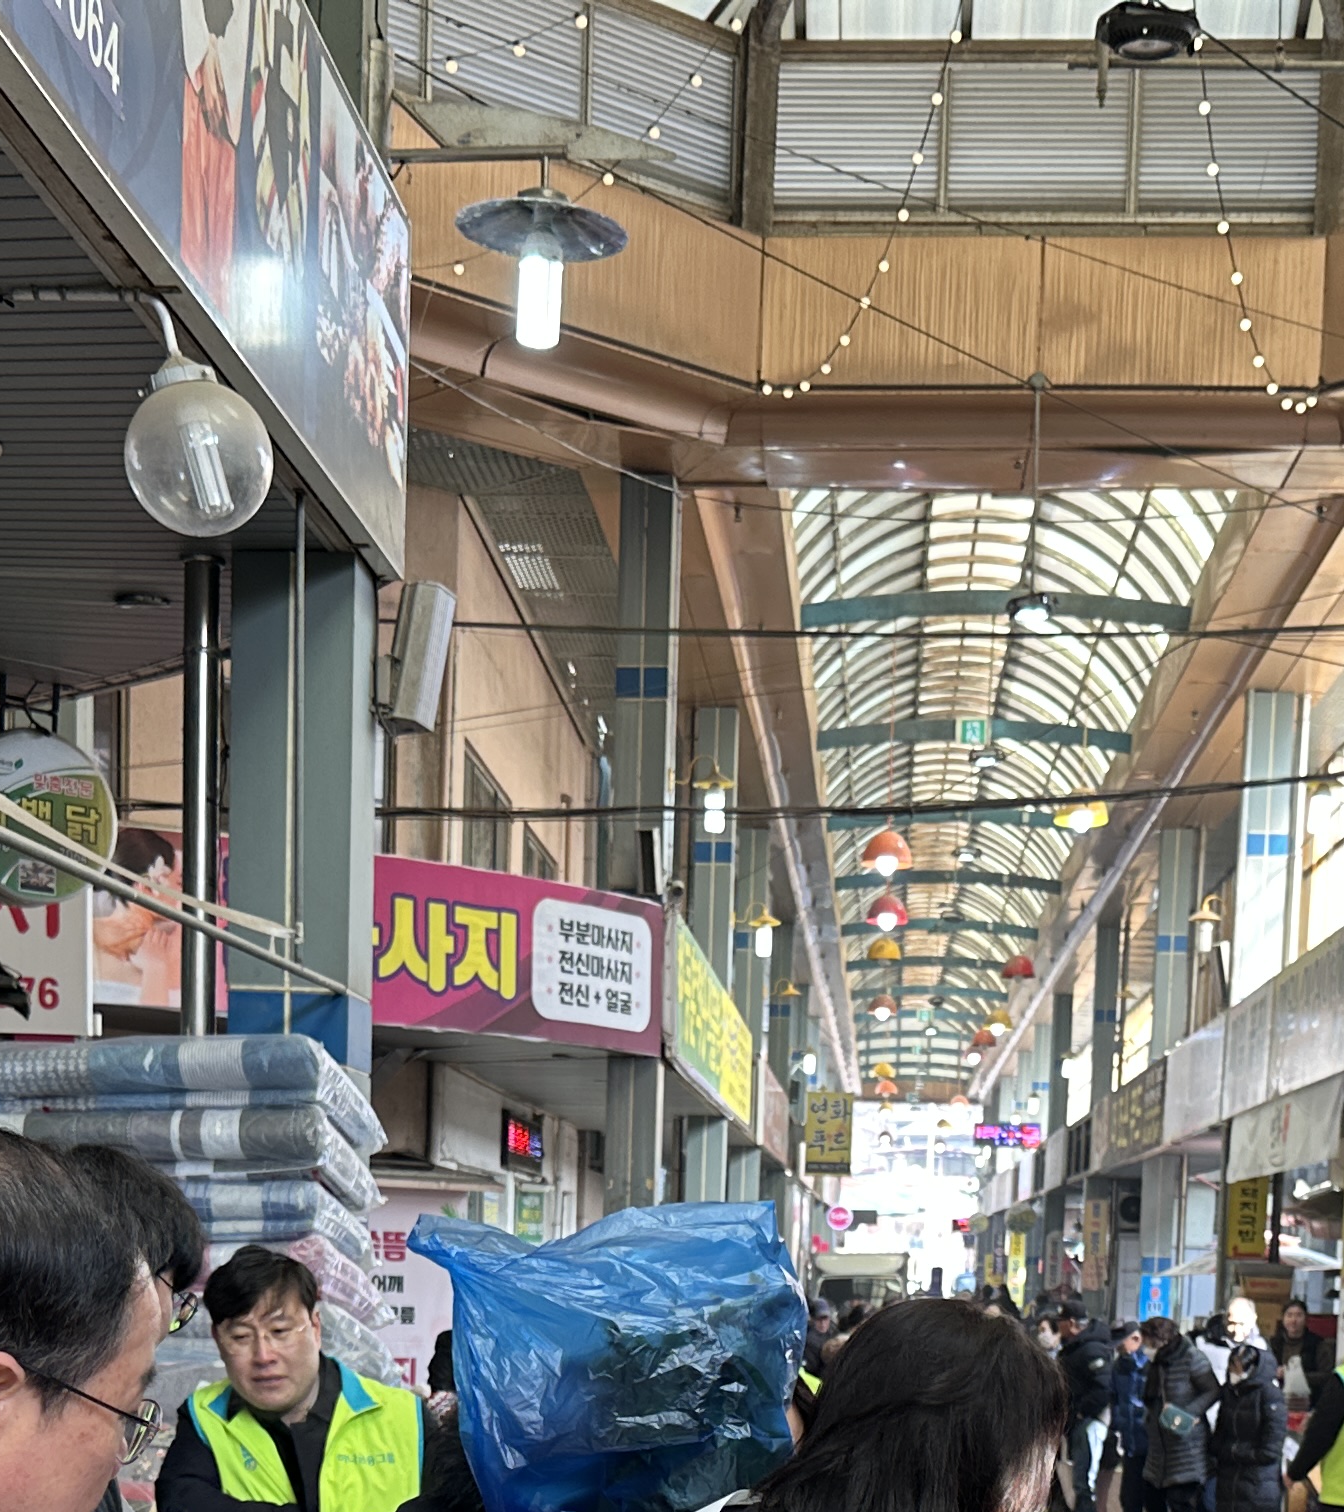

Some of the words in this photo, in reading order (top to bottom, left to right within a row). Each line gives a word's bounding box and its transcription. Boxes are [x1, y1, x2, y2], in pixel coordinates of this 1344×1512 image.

[373, 892, 520, 1000] 사지
[558, 917, 634, 954] 부분마사지
[557, 948, 634, 985] 전신마사지
[557, 981, 590, 1010] 전신
[605, 986, 633, 1016] 얼굴
